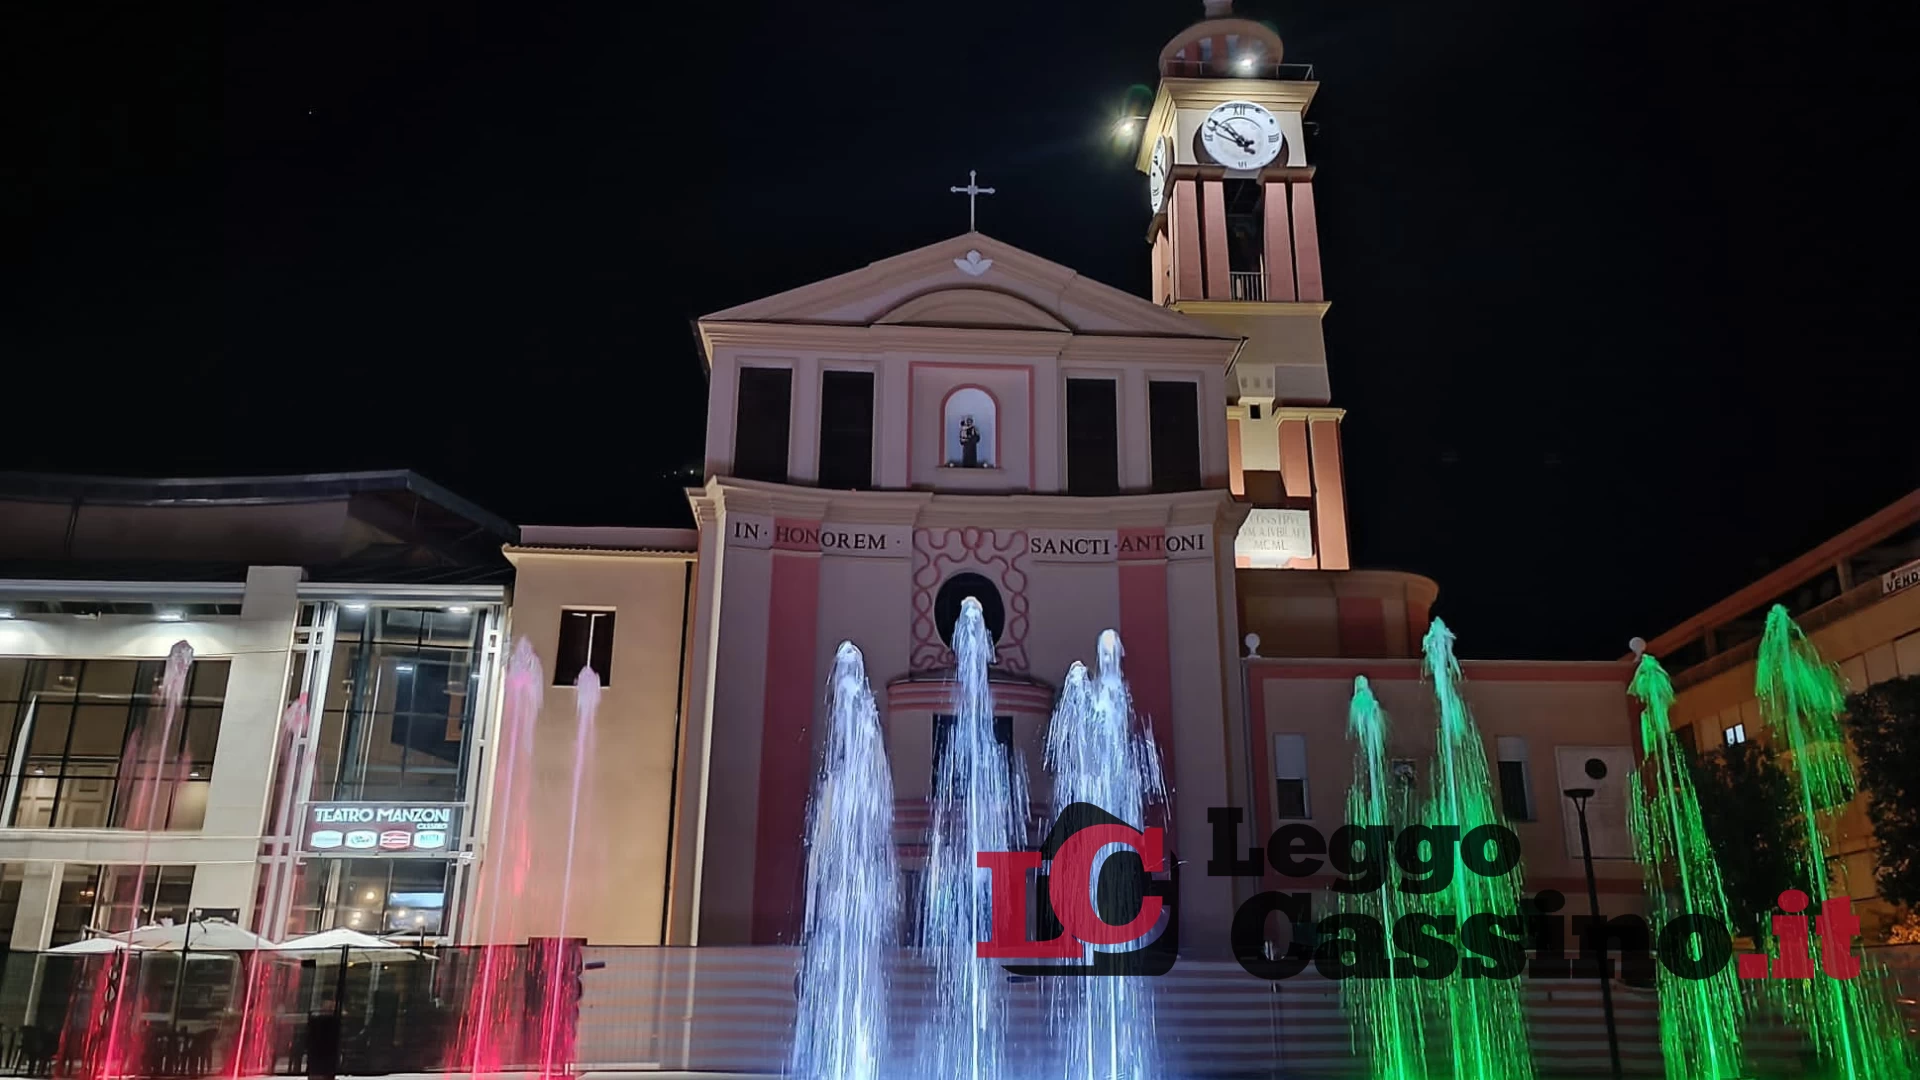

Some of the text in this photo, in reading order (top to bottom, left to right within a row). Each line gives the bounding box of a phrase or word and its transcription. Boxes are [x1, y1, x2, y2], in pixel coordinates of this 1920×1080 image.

[734, 522, 1206, 555] IN HONOREM SANCTI ANTONI
[315, 808, 450, 822] TEATRO MANZONI
